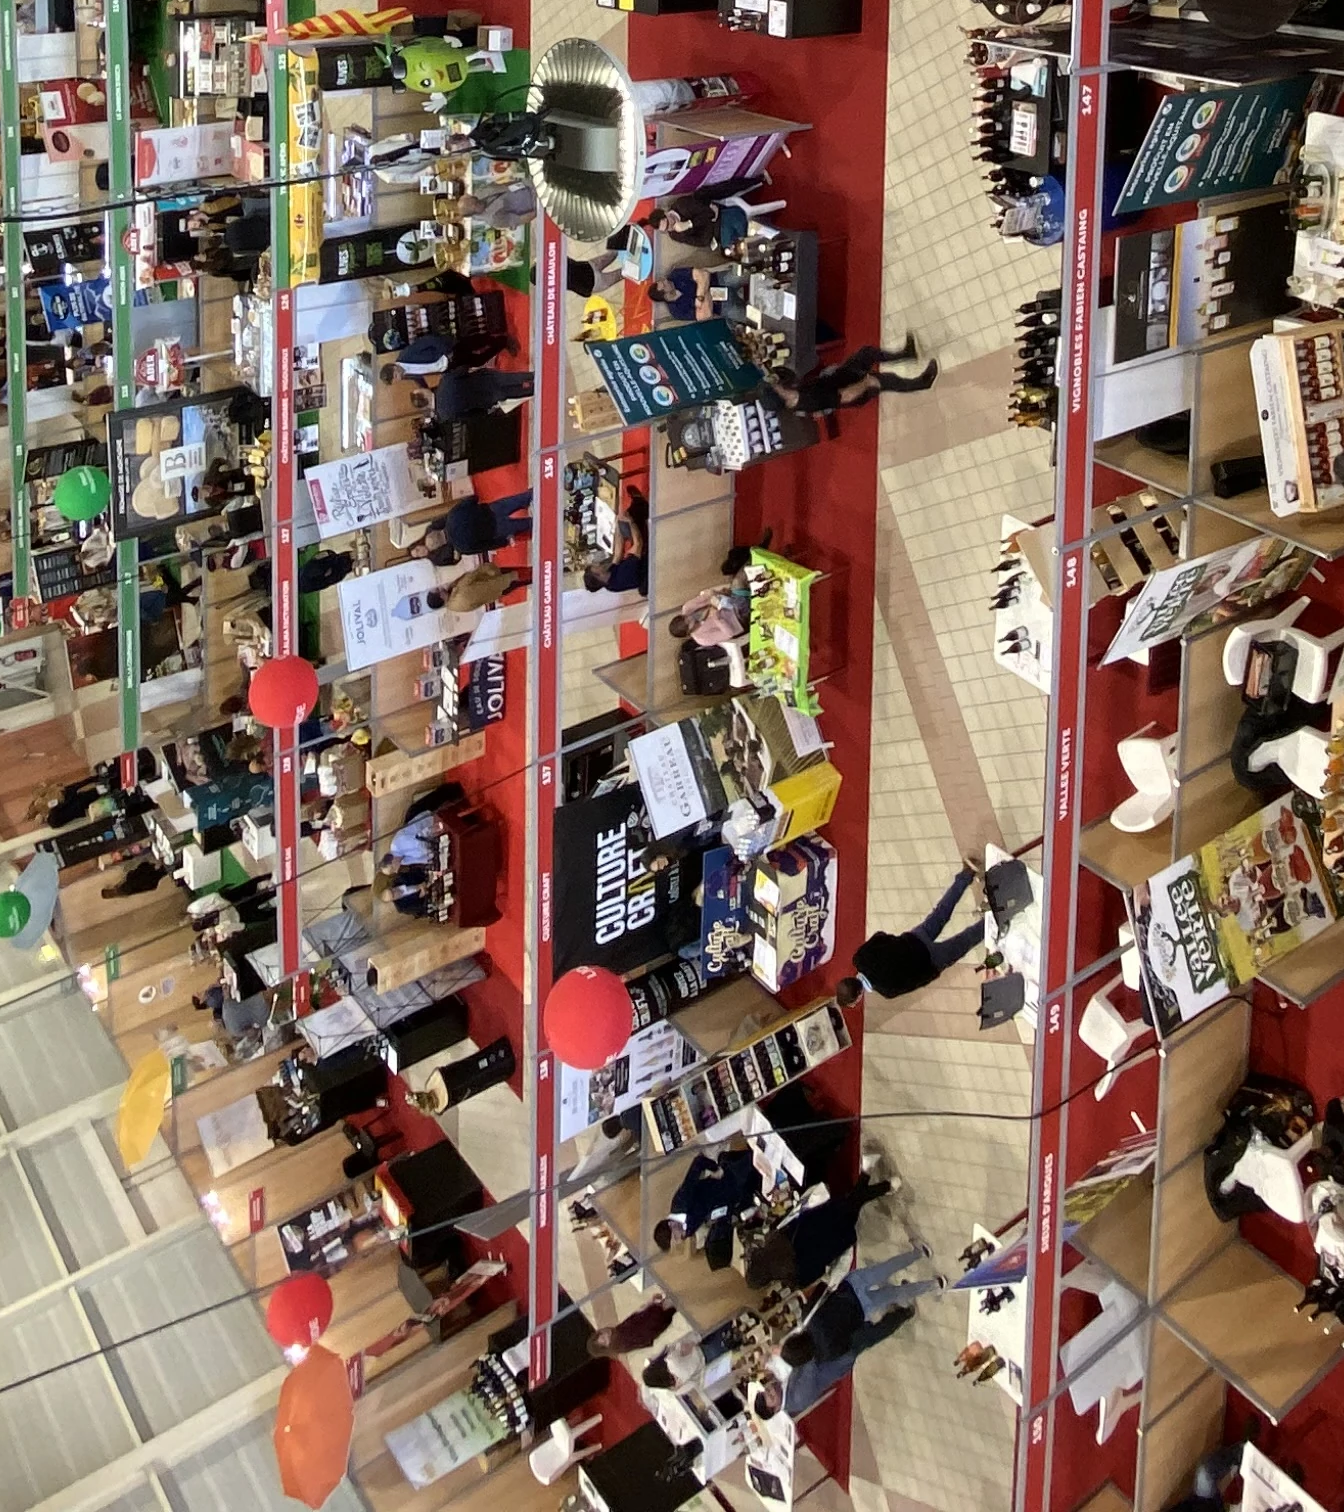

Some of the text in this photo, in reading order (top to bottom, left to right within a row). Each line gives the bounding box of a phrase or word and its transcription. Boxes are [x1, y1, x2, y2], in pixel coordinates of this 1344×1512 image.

[1081, 84, 1093, 116] 147
[1125, 151, 1153, 197] Entreprise
[1142, 97, 1196, 205] NOUVELLE-AQUITAINE
[1143, 122, 1176, 183] PRODUIT EN
[545, 241, 556, 345] CHÂTEAU DE BEAULON
[1071, 208, 1089, 413] VIGNOBLES FABIEN CASTAING
[544, 457, 554, 479] 136
[281, 528, 290, 544] 127
[1065, 556, 1078, 588] 148
[353, 599, 366, 645] JOLIVAL
[542, 560, 553, 648] CHÂTEAU GARREAU
[486, 651, 505, 720] JOLIVA
[542, 765, 551, 785] 137
[1060, 727, 1072, 770] VERTE
[662, 736, 692, 818] GARREAU
[541, 872, 550, 942] CULTURE CRAFT
[594, 822, 627, 945] CULTURE
[627, 847, 656, 931] CRAFT
[704, 920, 724, 972] Culture
[786, 897, 808, 962] Culture
[1049, 1003, 1061, 1034] 149
[1039, 1216, 1052, 1254] SIEUR
